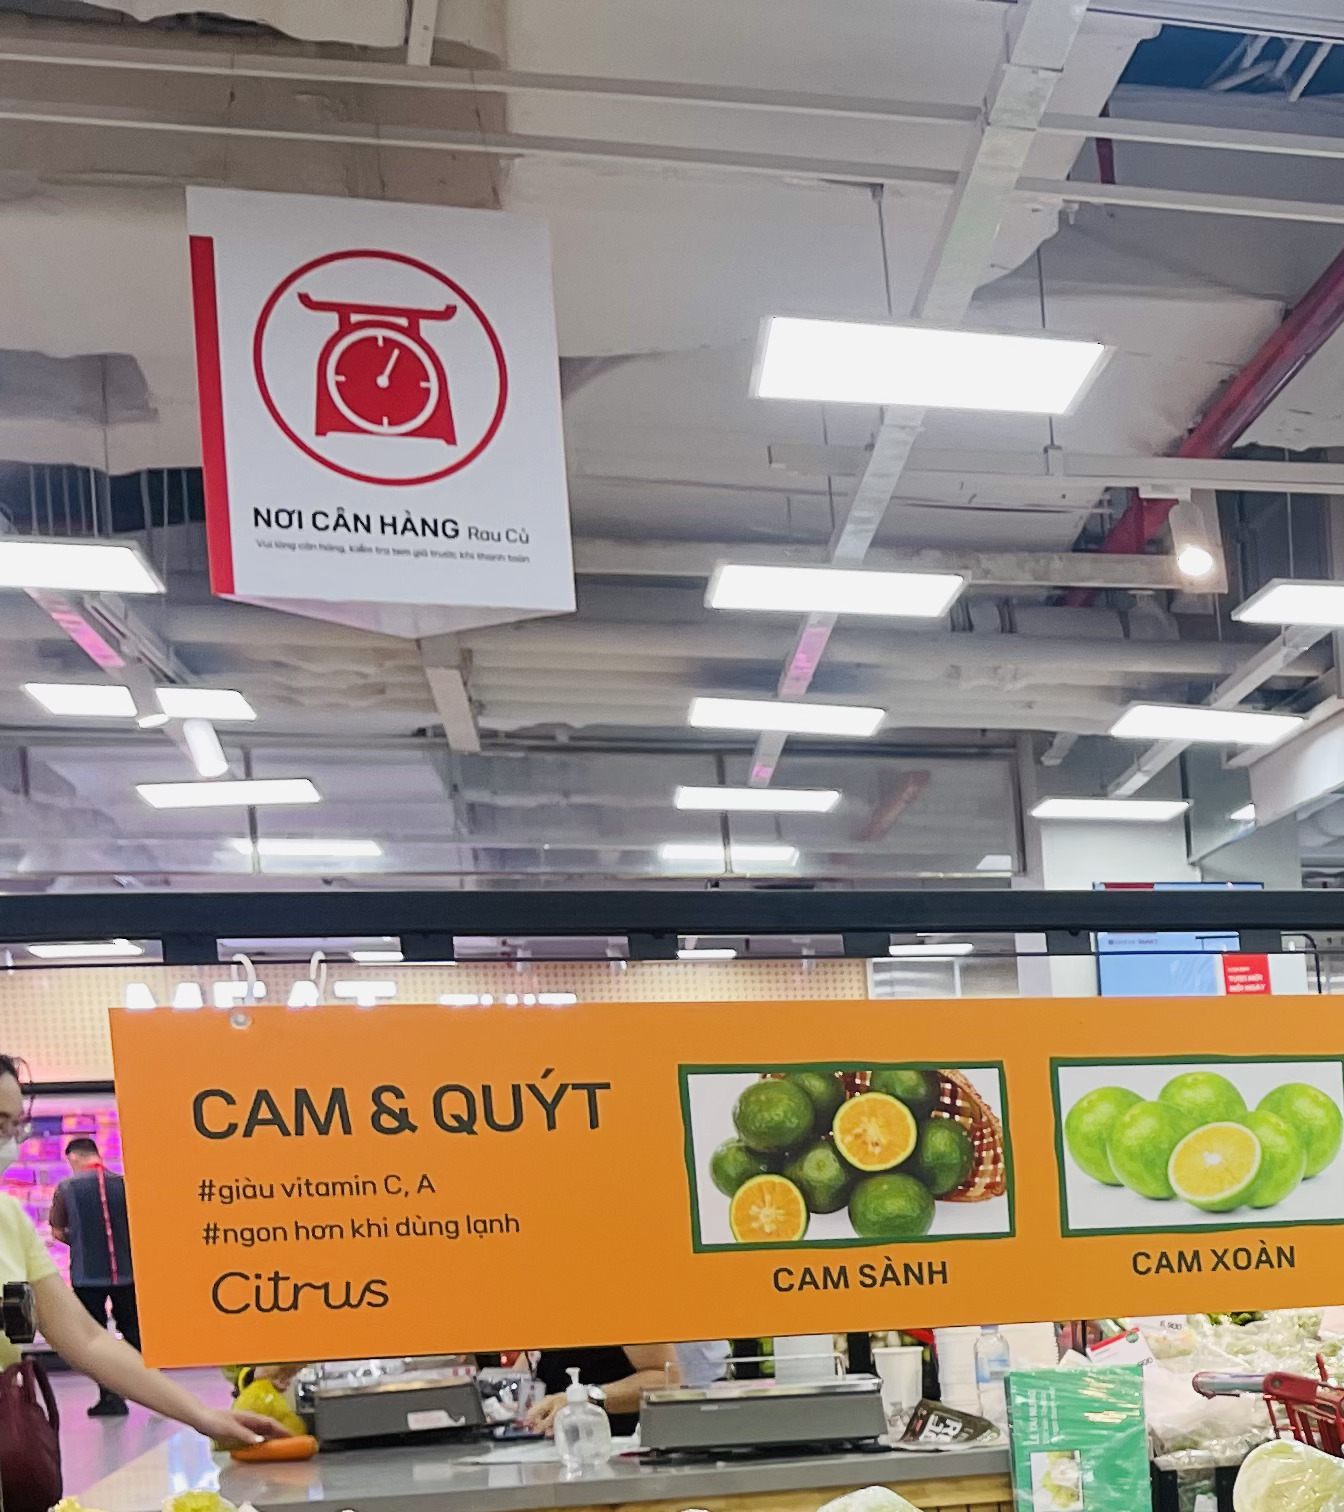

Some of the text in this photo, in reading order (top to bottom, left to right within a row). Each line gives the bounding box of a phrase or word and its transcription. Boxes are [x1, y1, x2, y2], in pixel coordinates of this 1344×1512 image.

[254, 506, 530, 545] NƠI CÂN HÀNG Rau Củ
[193, 1068, 611, 1139] CAM & QUÝT
[197, 1174, 436, 1205] #giàu vitamin C, A
[202, 1213, 520, 1247] #ngon hơn khi dùng lạnh
[771, 1255, 949, 1293] CAM SÀNH
[1131, 1239, 1297, 1276] CAM XOÀN
[211, 1270, 390, 1315] Citrus
